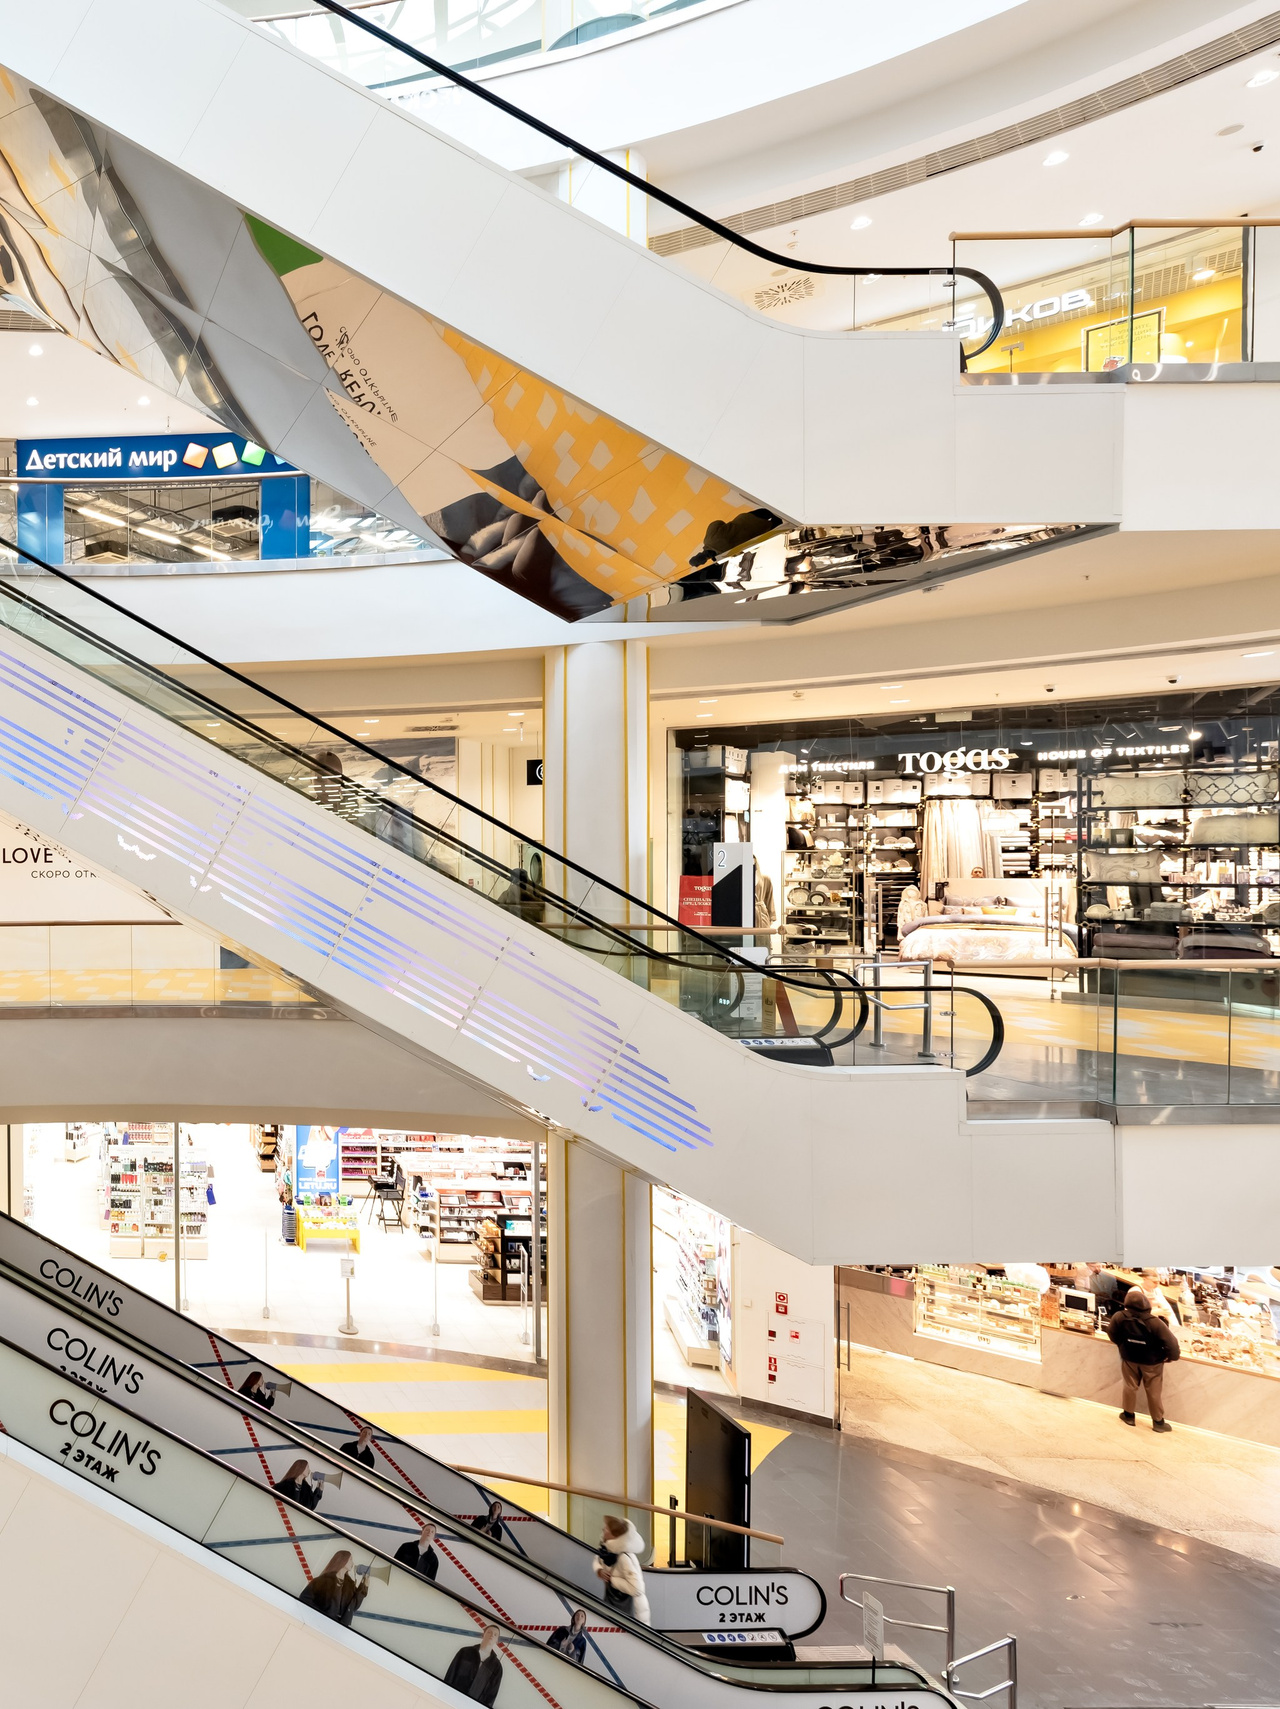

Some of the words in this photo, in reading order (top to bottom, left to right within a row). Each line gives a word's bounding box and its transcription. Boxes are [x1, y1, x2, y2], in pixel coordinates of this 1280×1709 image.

[25, 447, 123, 471] Детский
[128, 449, 178, 472] мир
[1037, 749, 1087, 761] HOUSE
[1091, 748, 1113, 758] OF
[1116, 744, 1191, 756] TEXTILES
[2, 848, 54, 863] LOVE
[718, 850, 726, 867] 2
[31, 870, 70, 878] СКОРО
[40, 1259, 123, 1317] COLIN'S
[47, 1328, 144, 1394] COLIN'S
[49, 1399, 161, 1475] COLIN'S
[60, 1442, 71, 1456] 2
[73, 1449, 120, 1482] ЭТАЖ
[697, 1582, 788, 1606] COLIN'S
[719, 1613, 726, 1623] 2
[729, 1613, 766, 1623] ЭТАЖ
